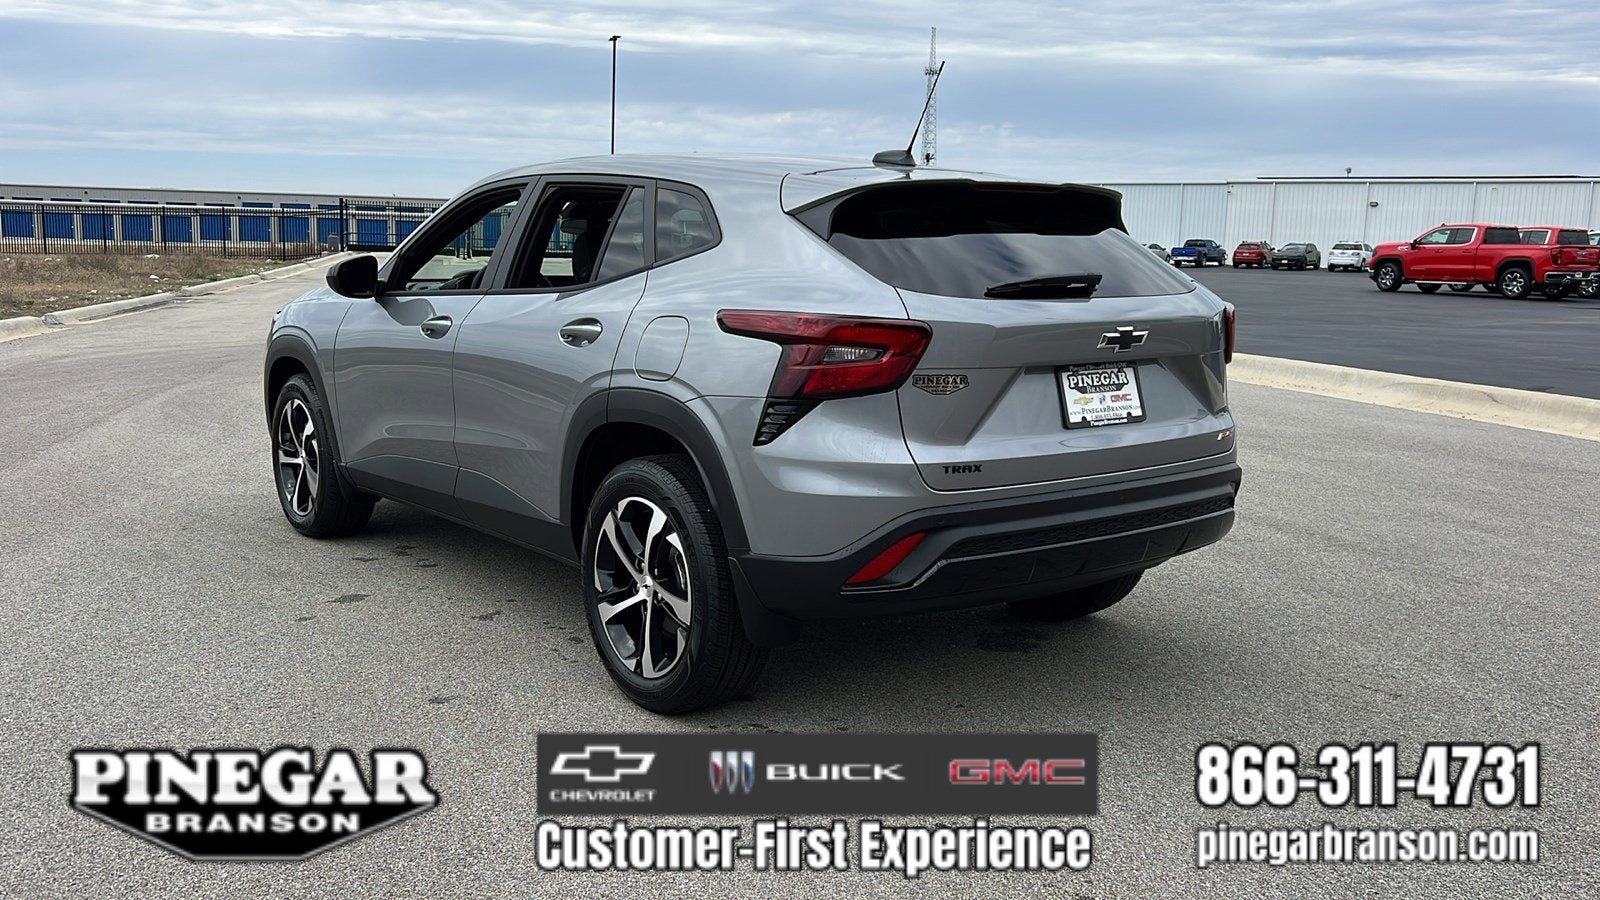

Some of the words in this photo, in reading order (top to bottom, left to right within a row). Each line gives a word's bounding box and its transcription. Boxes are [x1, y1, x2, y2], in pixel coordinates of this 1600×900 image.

[915, 376, 967, 385] PINEGAR
[1068, 372, 1128, 388] PINEGAR
[1087, 385, 1116, 394] BRANSON
[1110, 394, 1132, 402] GMC
[942, 464, 982, 474] TRAX
